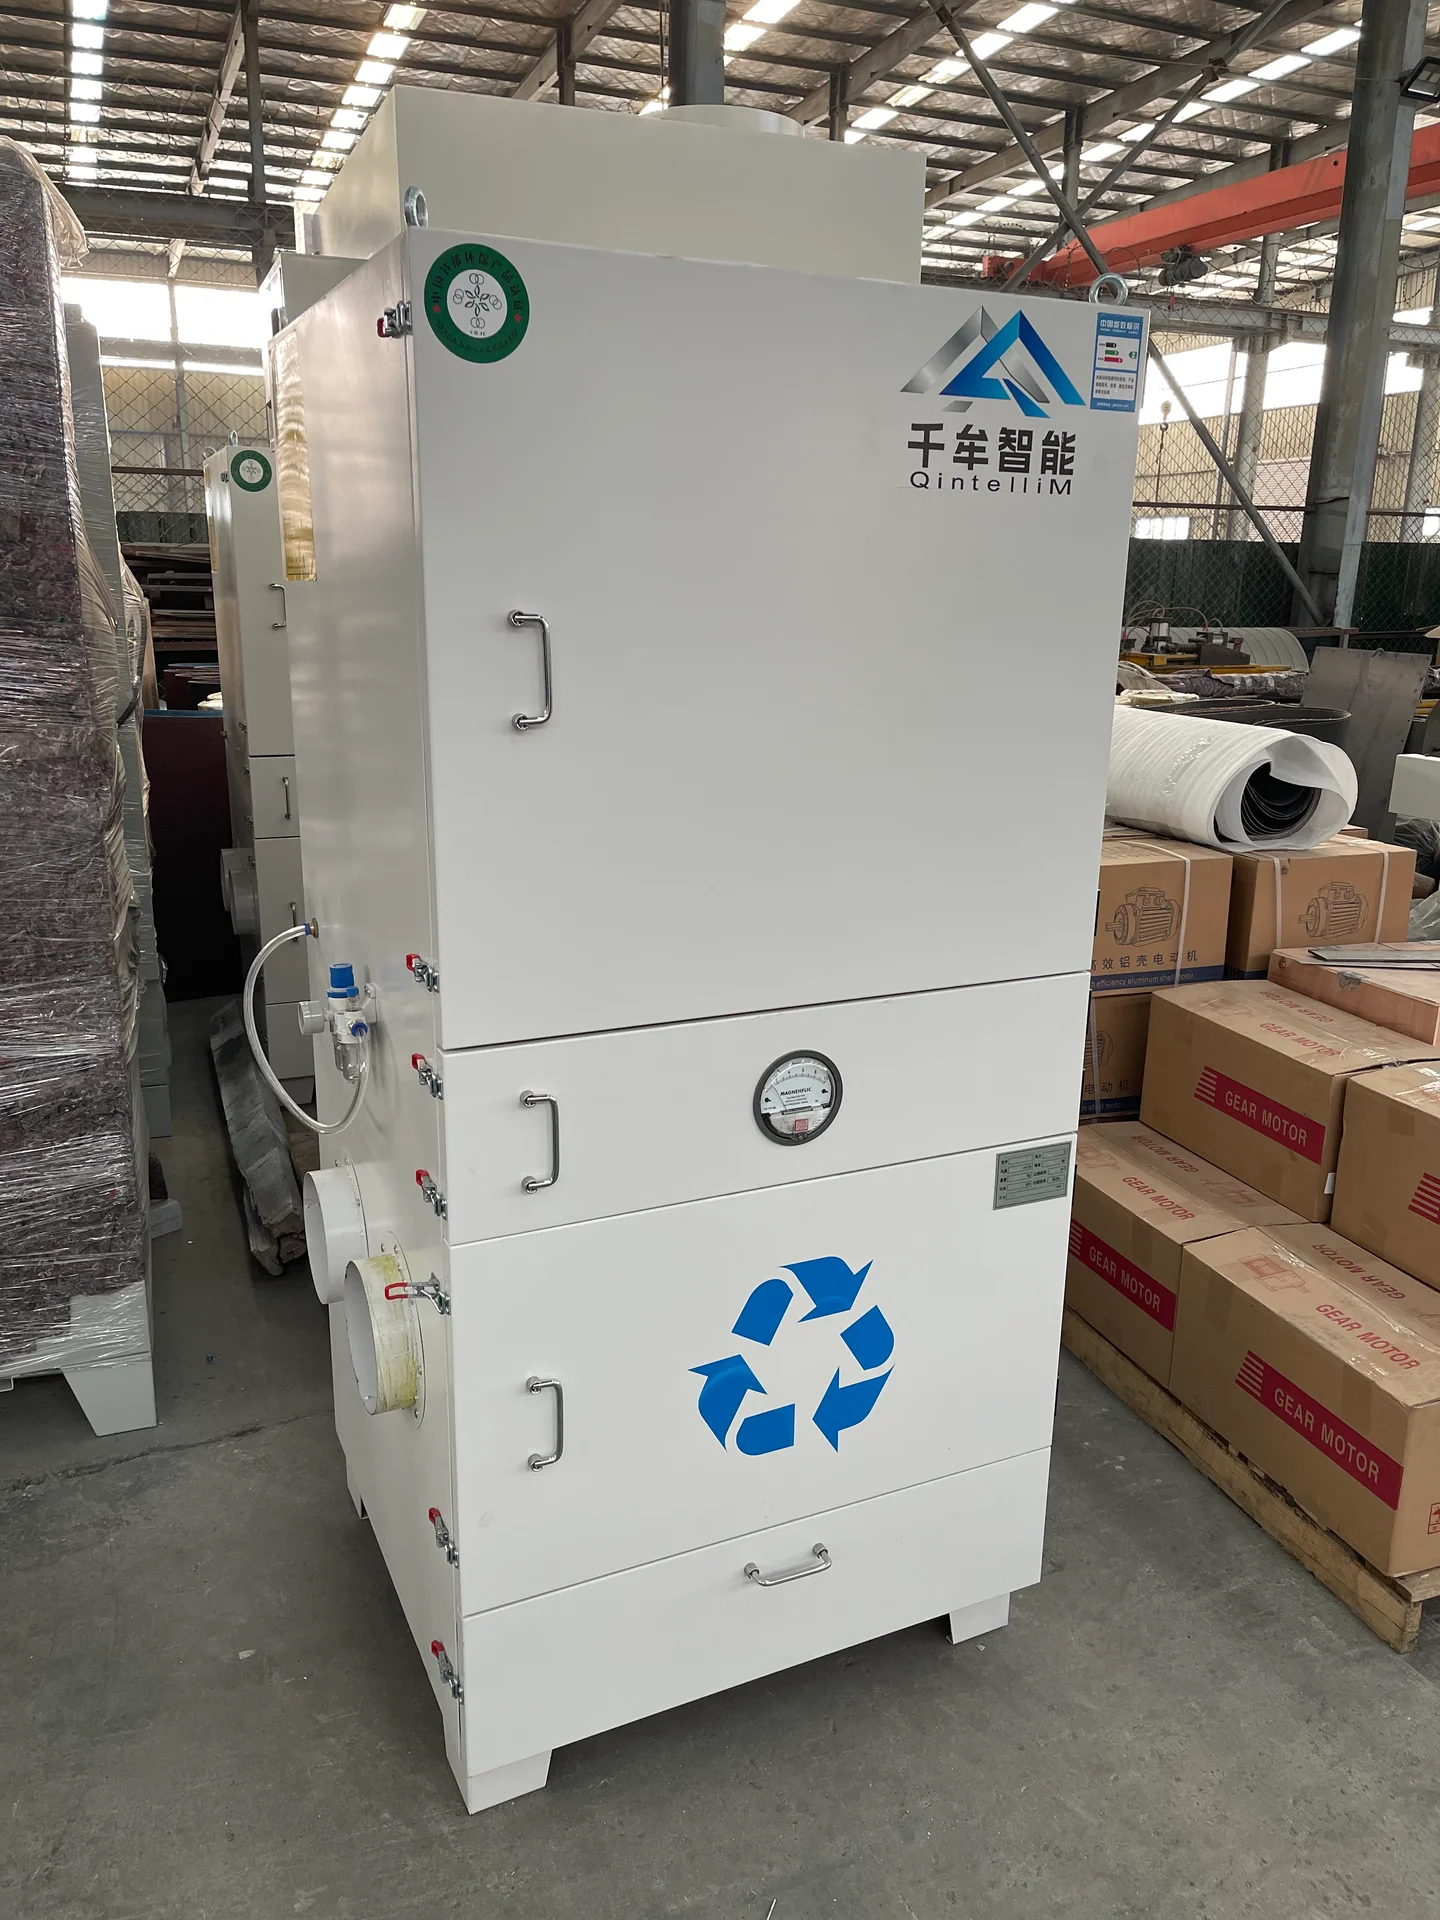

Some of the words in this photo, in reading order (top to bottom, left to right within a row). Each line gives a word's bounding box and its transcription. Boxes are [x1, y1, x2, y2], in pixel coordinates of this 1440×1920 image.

[907, 423, 1076, 476] 千牟智能
[910, 471, 1072, 496] QintelliM
[1096, 978, 1127, 988] efficiency
[1127, 976, 1159, 984] aluminum
[1259, 991, 1303, 1009] MOTOR
[1297, 1008, 1334, 1023] GEAR
[1260, 1022, 1297, 1038] GEAR
[1291, 1037, 1341, 1056] MOTOR
[1225, 1090, 1257, 1120] GEAR
[1261, 1109, 1308, 1147] MOTOR
[1131, 1135, 1172, 1155] MOTOR
[1166, 1156, 1199, 1172] GEAR
[1122, 1176, 1156, 1196] GEAR
[1150, 1195, 1196, 1220] MOTOR
[1311, 1243, 1366, 1274] MOTOR
[1089, 1246, 1117, 1279] GEAR
[1120, 1269, 1161, 1313] MOTOR
[1361, 1275, 1406, 1300] GEAR
[1315, 1304, 1362, 1332] GEAR
[1356, 1331, 1421, 1370] MOTOR
[1274, 1388, 1315, 1432] GEAR
[1321, 1422, 1380, 1484] MOTOR
